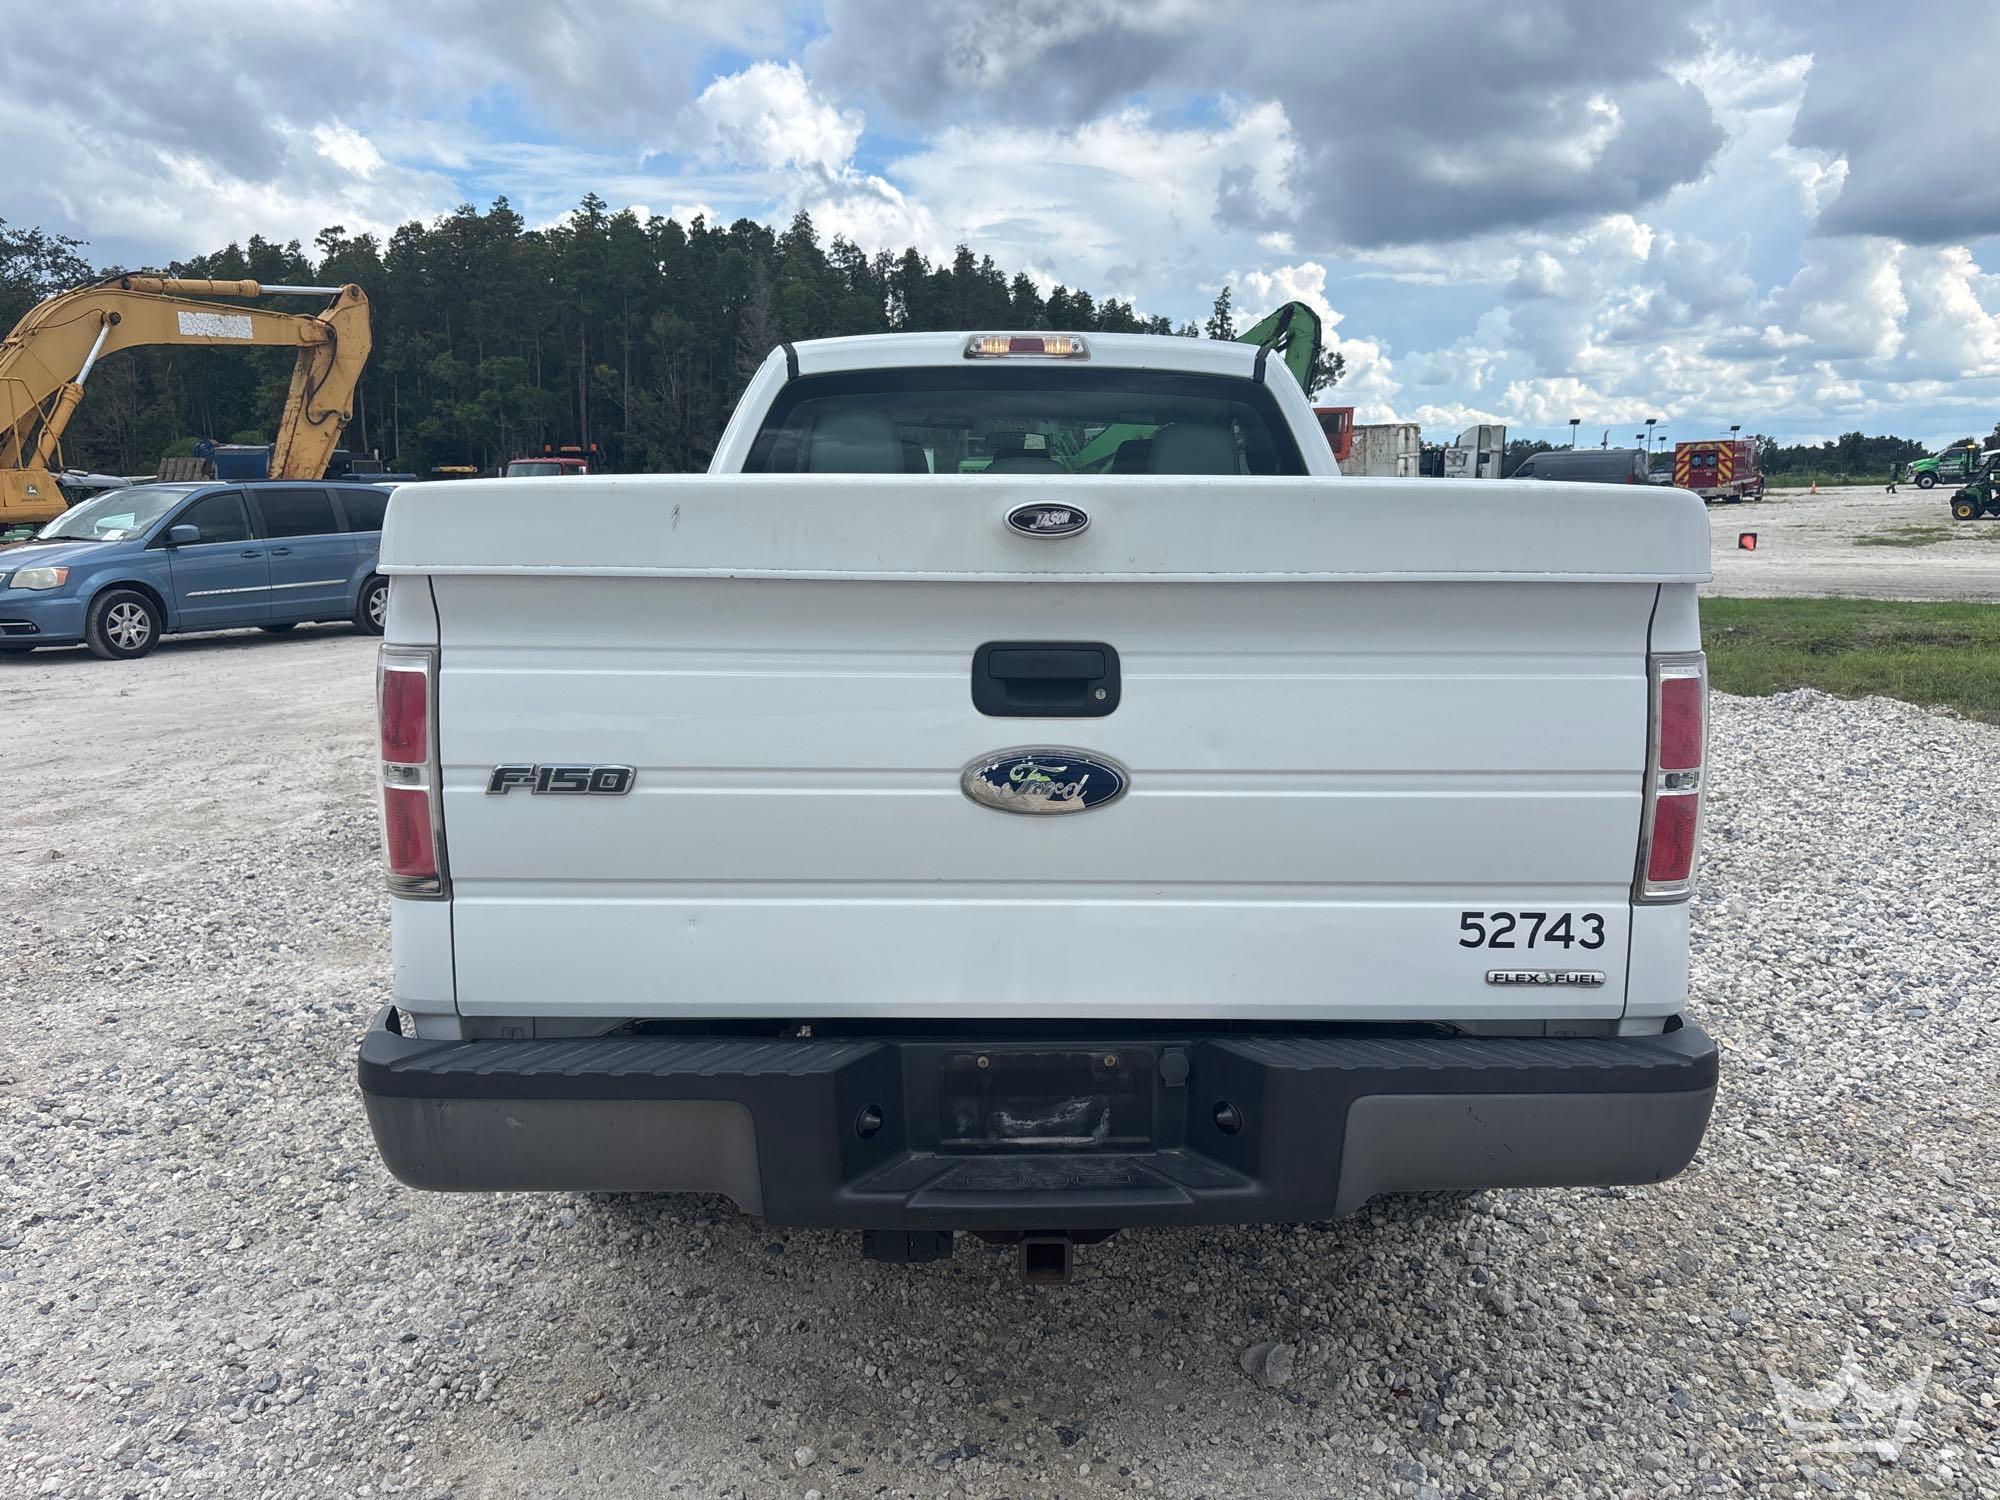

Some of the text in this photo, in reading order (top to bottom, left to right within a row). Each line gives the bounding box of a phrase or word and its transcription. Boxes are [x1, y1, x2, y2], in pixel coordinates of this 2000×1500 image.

[1029, 510, 1071, 529] JASON
[486, 763, 637, 795] F-150
[1009, 763, 1090, 801] Ford
[1459, 911, 1605, 950] 52743
[1493, 973, 1601, 984] FLEX FUEL
